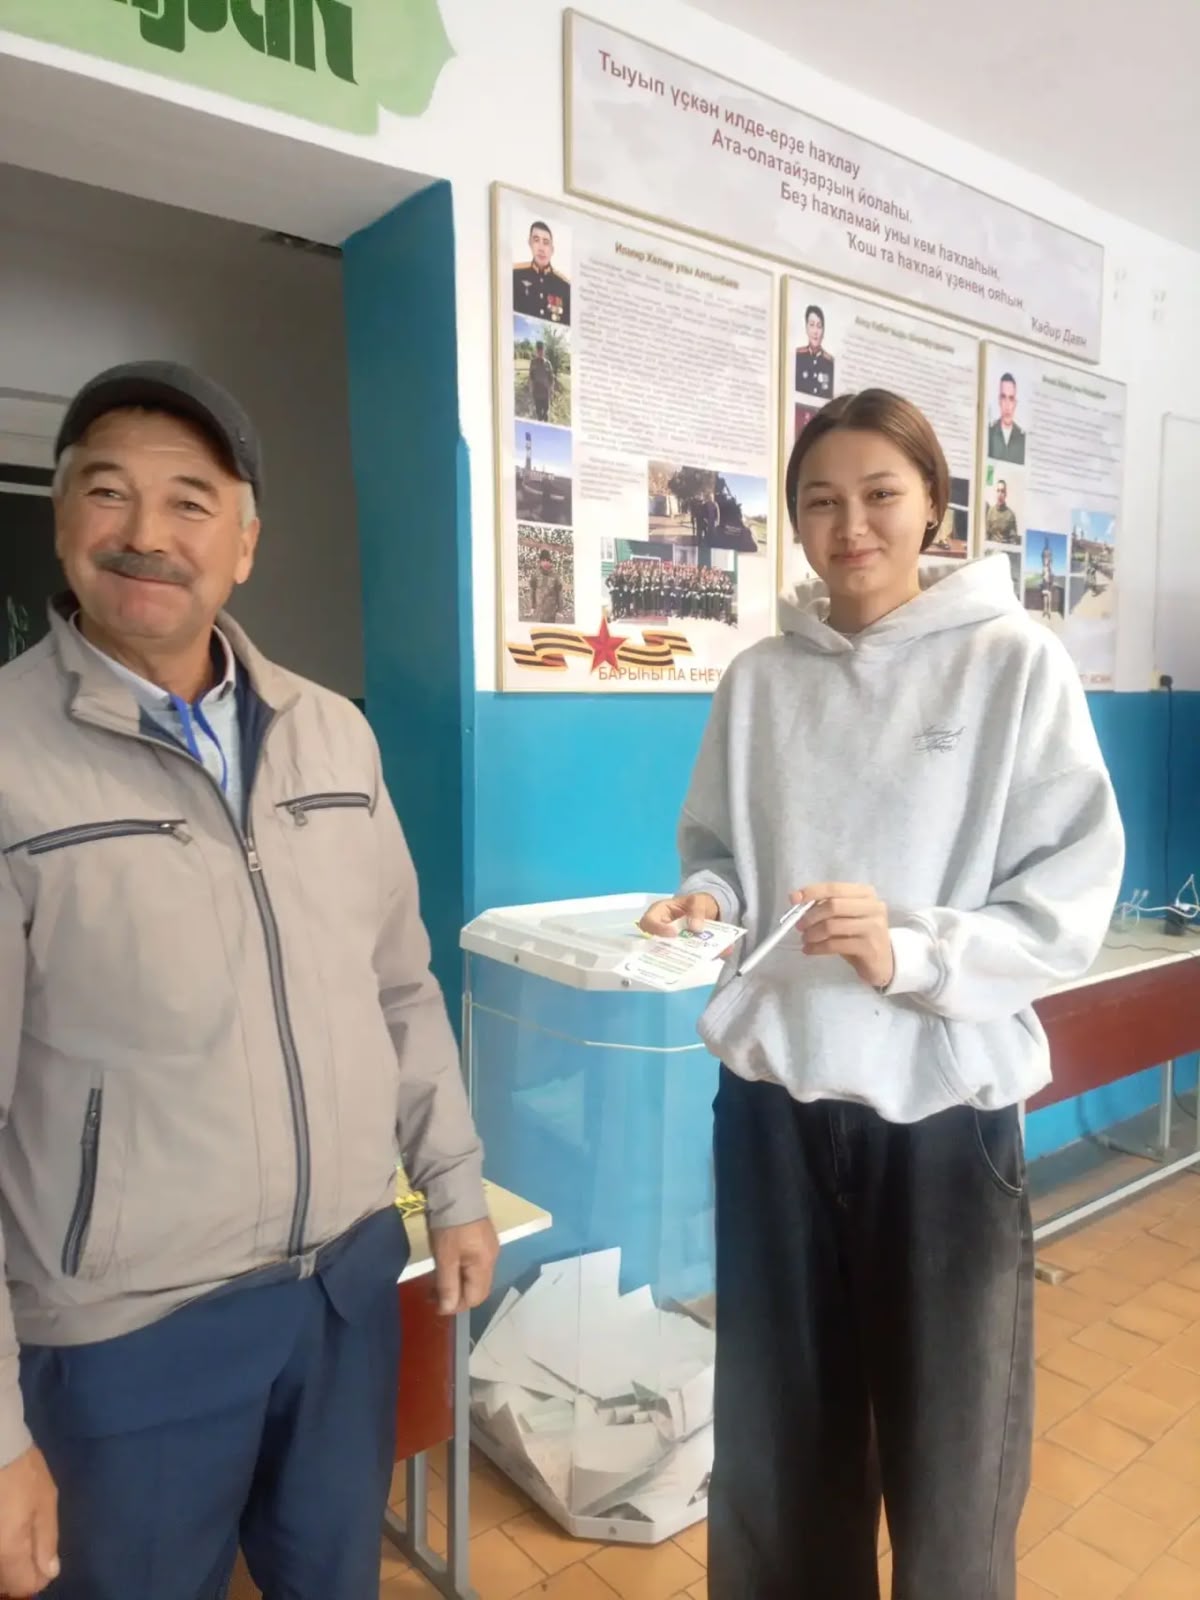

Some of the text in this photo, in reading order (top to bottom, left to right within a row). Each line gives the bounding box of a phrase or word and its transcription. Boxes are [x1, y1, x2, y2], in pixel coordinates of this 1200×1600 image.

[598, 49, 665, 96] Тыуып
[670, 85, 719, 119] үҫкән
[809, 140, 860, 180] һаҡлау
[780, 181, 807, 211] Беҙ
[884, 226, 910, 246] уны
[914, 237, 936, 255] кем
[880, 248, 894, 263] та
